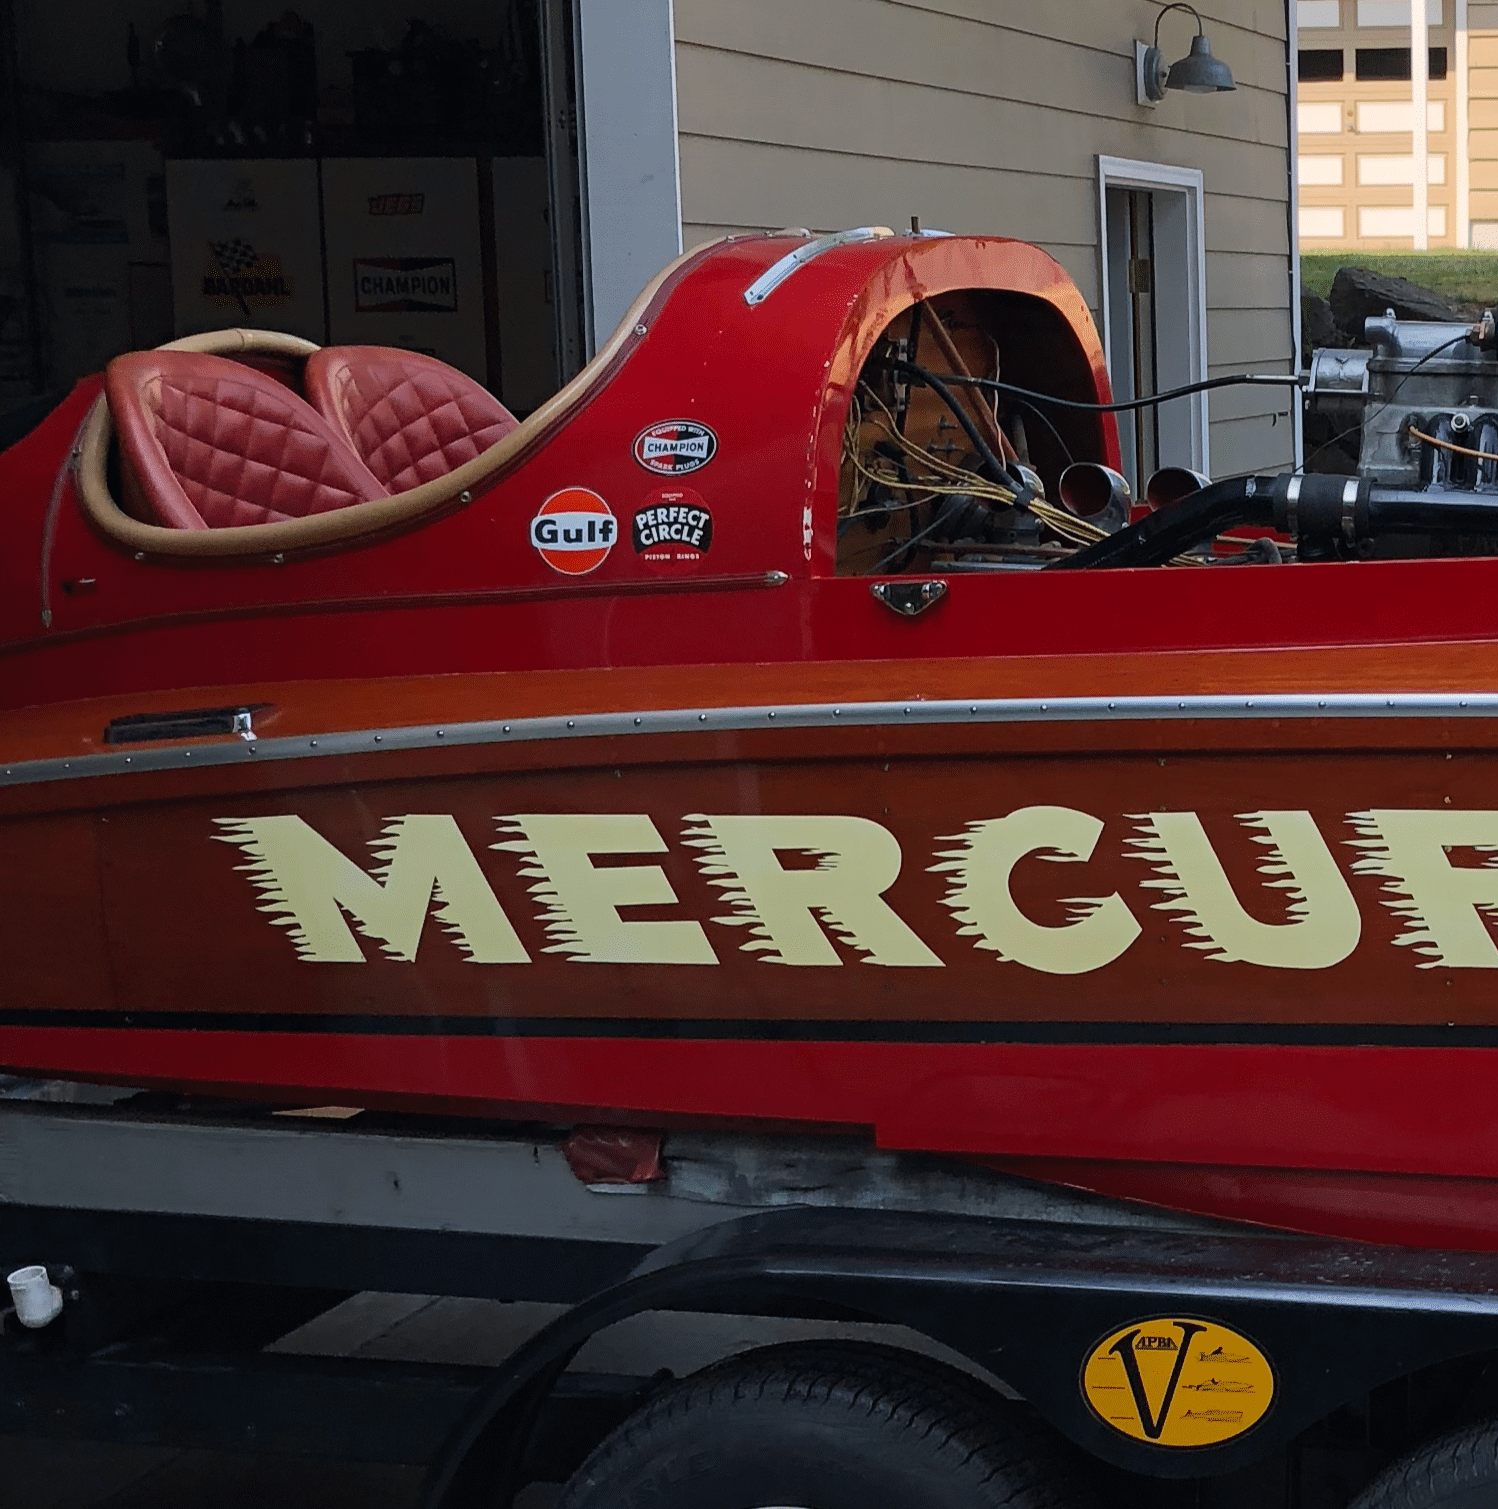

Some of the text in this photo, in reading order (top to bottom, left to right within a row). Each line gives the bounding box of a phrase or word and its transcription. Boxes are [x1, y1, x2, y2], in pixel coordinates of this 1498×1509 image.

[203, 277, 291, 295] BARDAHL
[361, 276, 451, 294] CHAMPION
[647, 442, 705, 453] CHAMPION
[650, 458, 700, 471] SPARK PLUGS
[635, 506, 710, 530] PERFECT
[534, 519, 614, 544] Gulf
[640, 524, 704, 546] CIRCLE
[1135, 1336, 1178, 1350] APBA
